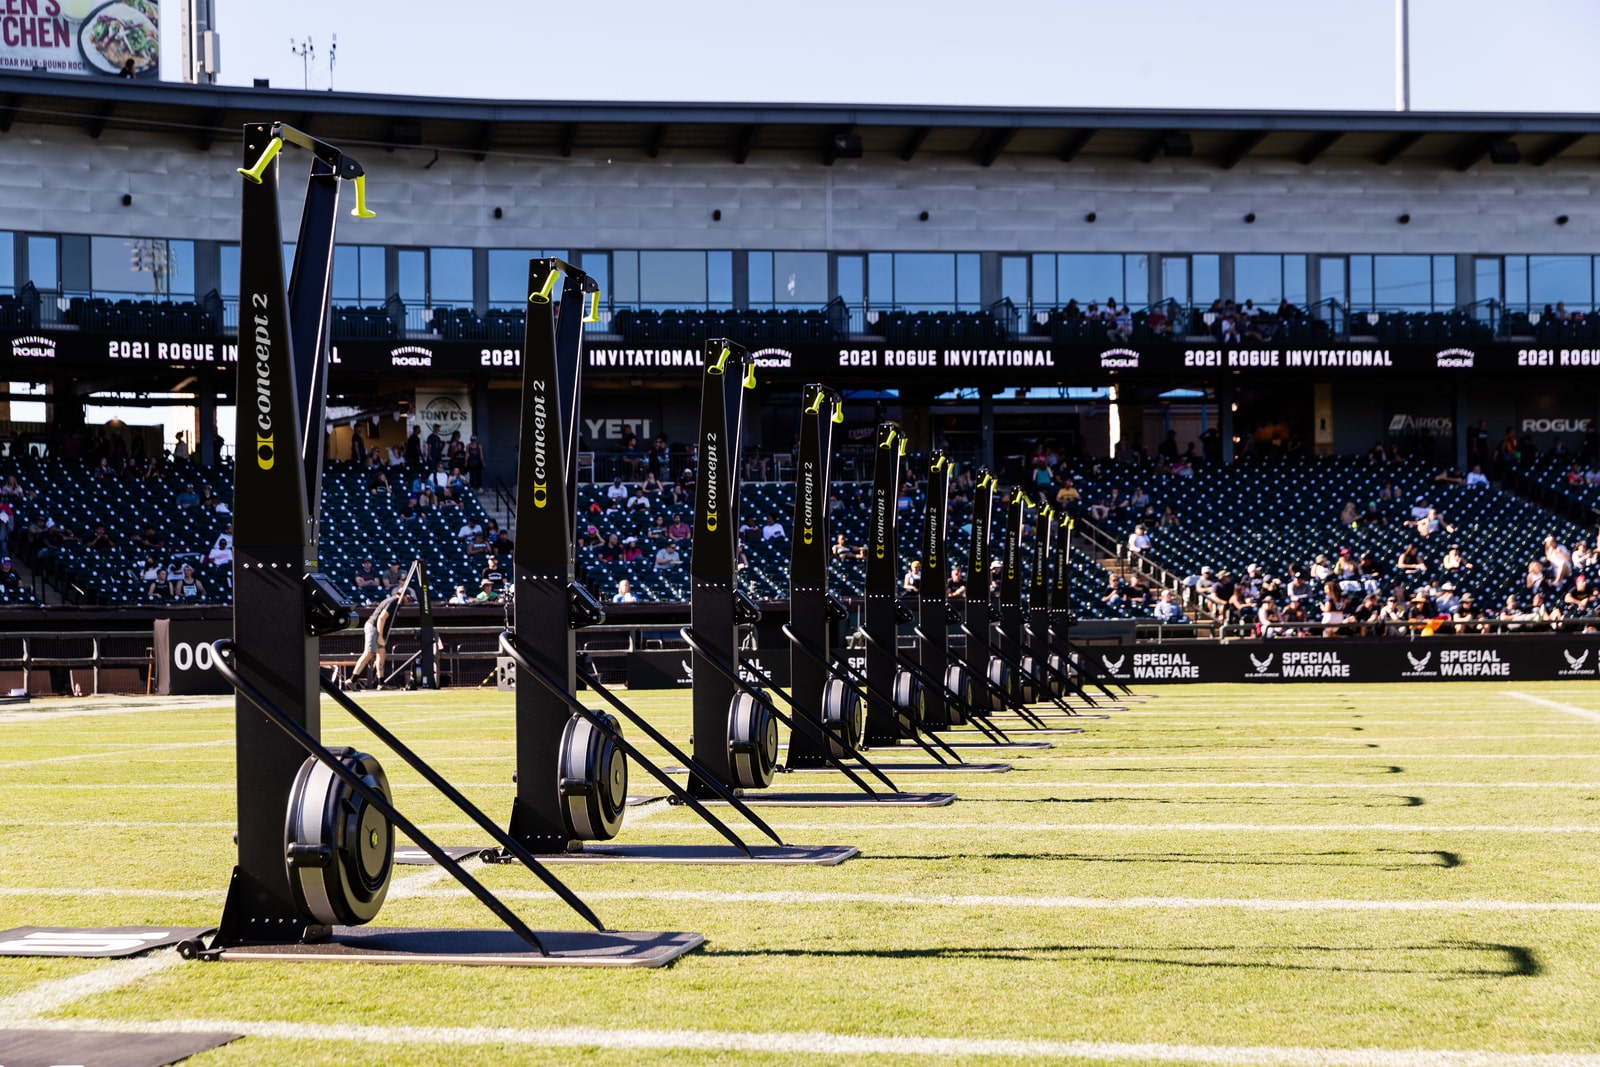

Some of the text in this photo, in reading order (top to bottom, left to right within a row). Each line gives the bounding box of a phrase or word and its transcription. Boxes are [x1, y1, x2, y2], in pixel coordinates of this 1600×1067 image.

[0, 16, 70, 47] CHEN
[21, 59, 38, 67] PARK
[42, 60, 66, 69] ROUND
[68, 61, 88, 70] ROCK
[11, 336, 56, 348] INVITATIONAL
[13, 347, 55, 357] ROGUE
[109, 341, 149, 358] 2021
[158, 343, 215, 361] ROGUE
[252, 294, 272, 431] concept 2
[392, 357, 431, 366] ROGUE
[481, 350, 520, 366] 2021
[590, 350, 705, 366] INVITATIONAL
[754, 359, 791, 367] ROGUE
[840, 350, 1055, 366] 2021 ROGUE INVITATIONAL
[1101, 358, 1138, 367] ROGUE
[1185, 350, 1393, 367] 2021 ROGUE INVITATIONAL
[1437, 358, 1473, 367] ROGUE
[1518, 350, 1600, 366] 2021 ROGU
[419, 411, 448, 421] TONY
[534, 380, 547, 480] concept 2
[584, 419, 650, 439] YETI
[1522, 419, 1591, 432] ROGUE
[706, 432, 717, 510] concept 2
[804, 472, 814, 526] concept
[877, 499, 886, 543] concept
[1133, 653, 1190, 665] SPECIAL
[1282, 652, 1341, 664] SPECIAL
[1440, 650, 1501, 662] SPECIAL
[1133, 666, 1200, 678] WARFARE
[1282, 665, 1351, 677] WARFARE
[1440, 663, 1510, 676] WARFARE
